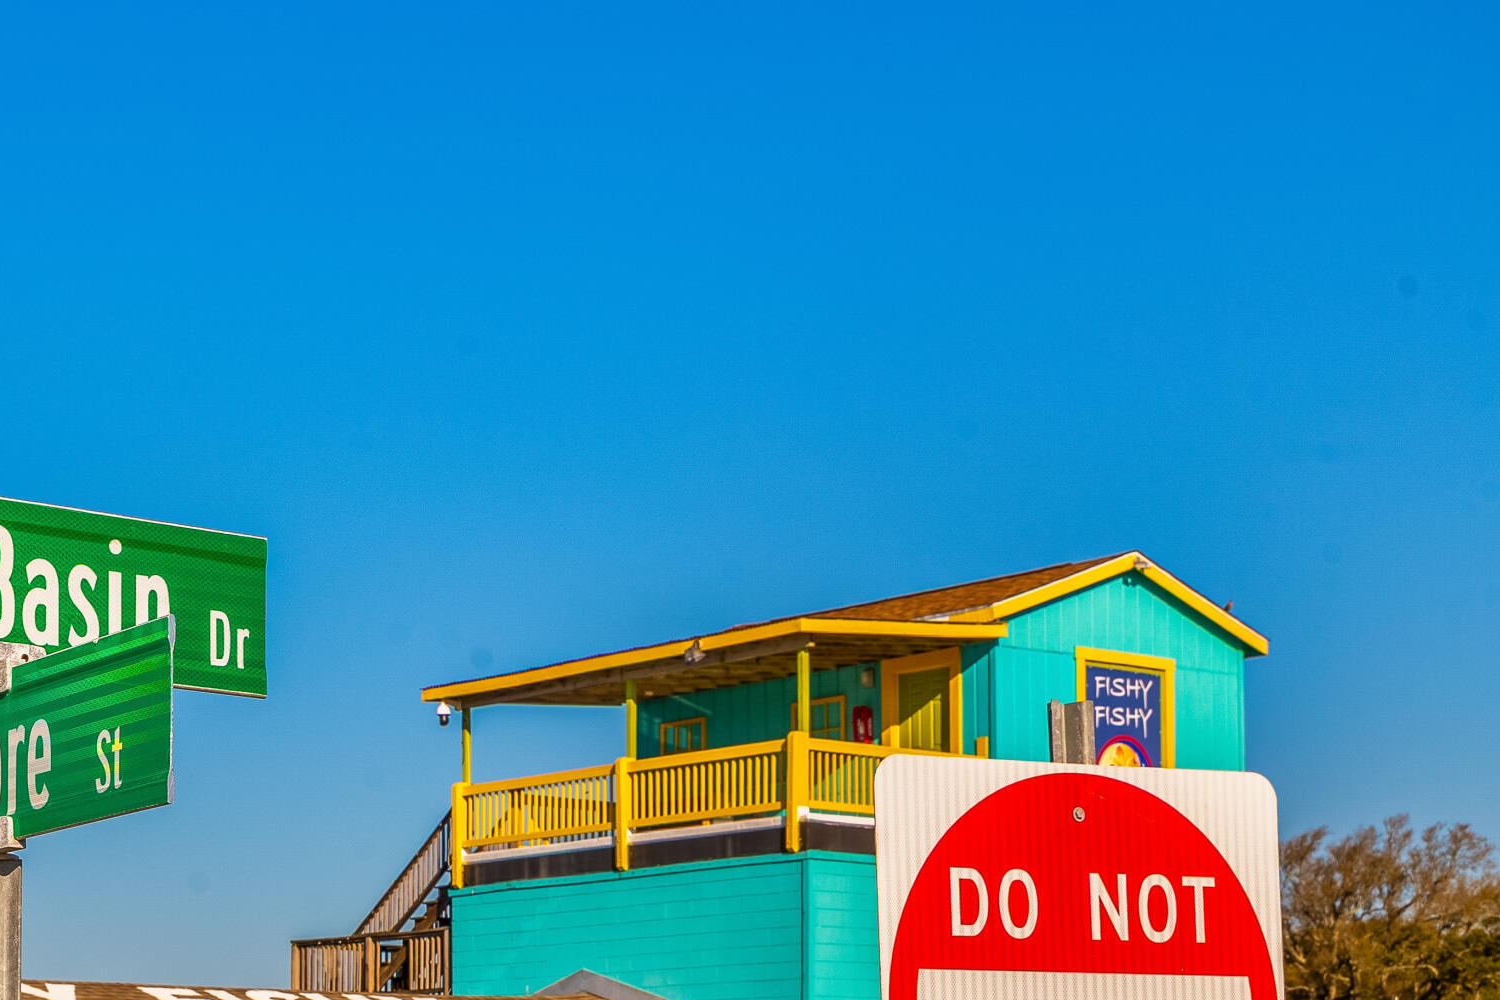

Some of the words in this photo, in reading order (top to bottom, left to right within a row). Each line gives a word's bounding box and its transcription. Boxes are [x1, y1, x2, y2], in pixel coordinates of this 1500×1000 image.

[210, 610, 250, 670] Dr
[1094, 676, 1153, 709] FISHY
[1094, 706, 1153, 738] FISHY
[96, 726, 123, 794] St
[949, 867, 1038, 939] DO
[1089, 873, 1216, 944] NOT
